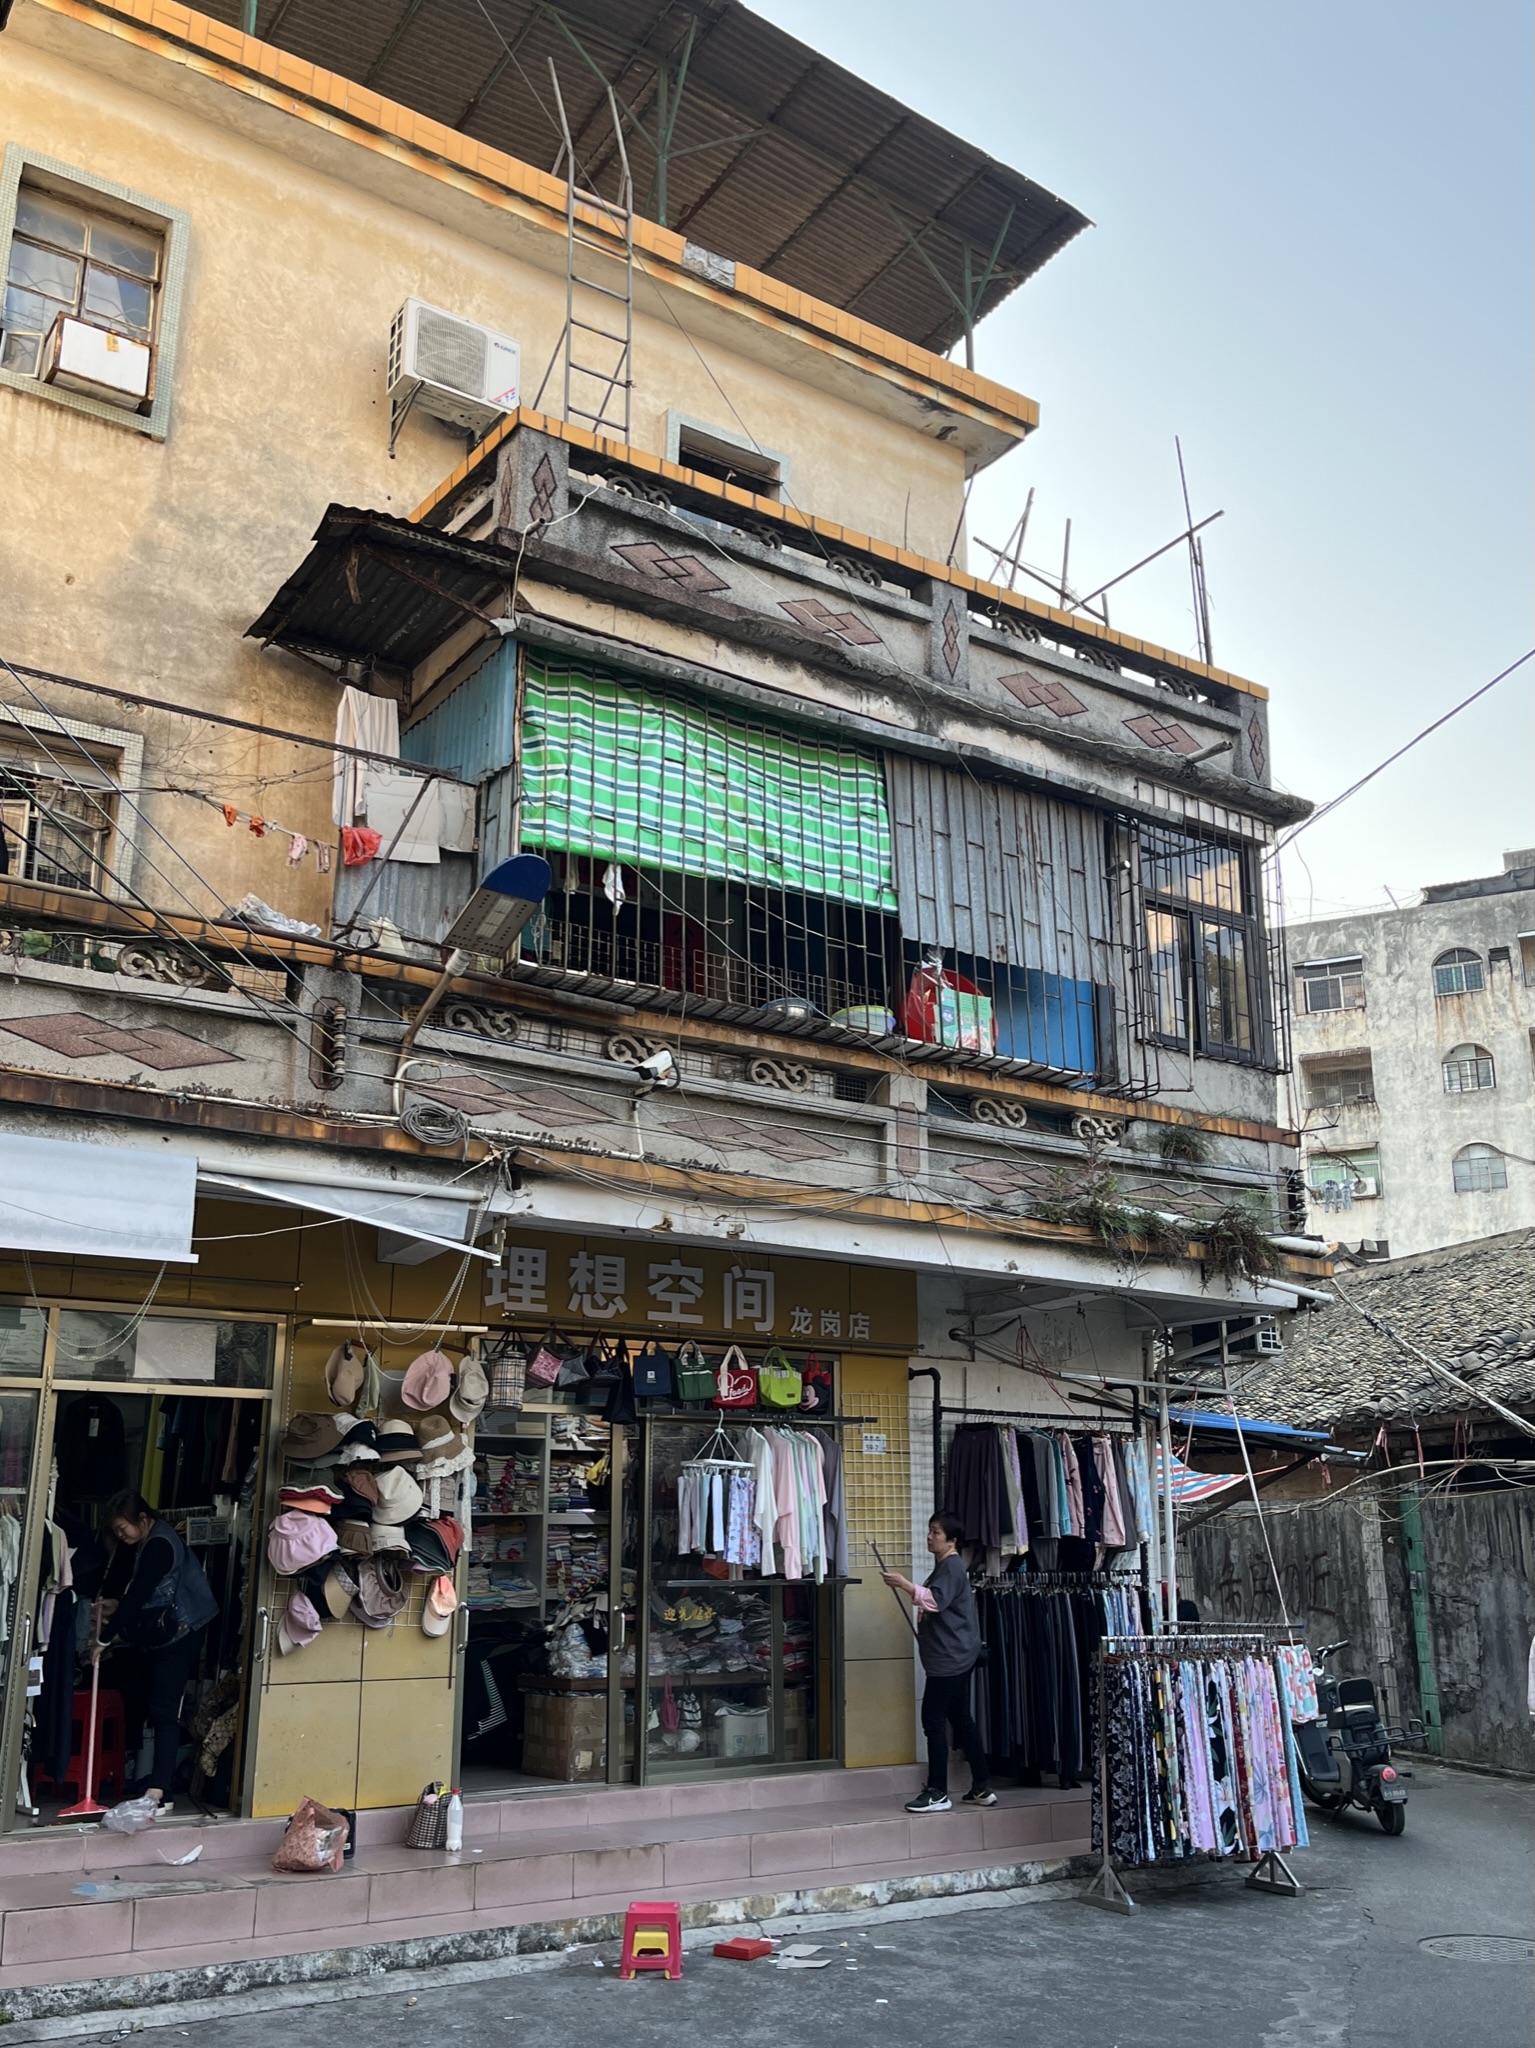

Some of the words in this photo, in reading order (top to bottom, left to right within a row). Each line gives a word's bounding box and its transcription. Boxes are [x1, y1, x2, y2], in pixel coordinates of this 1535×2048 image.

[484, 1245, 775, 1332] 理想空间
[790, 1306, 871, 1340] 龙岗店
